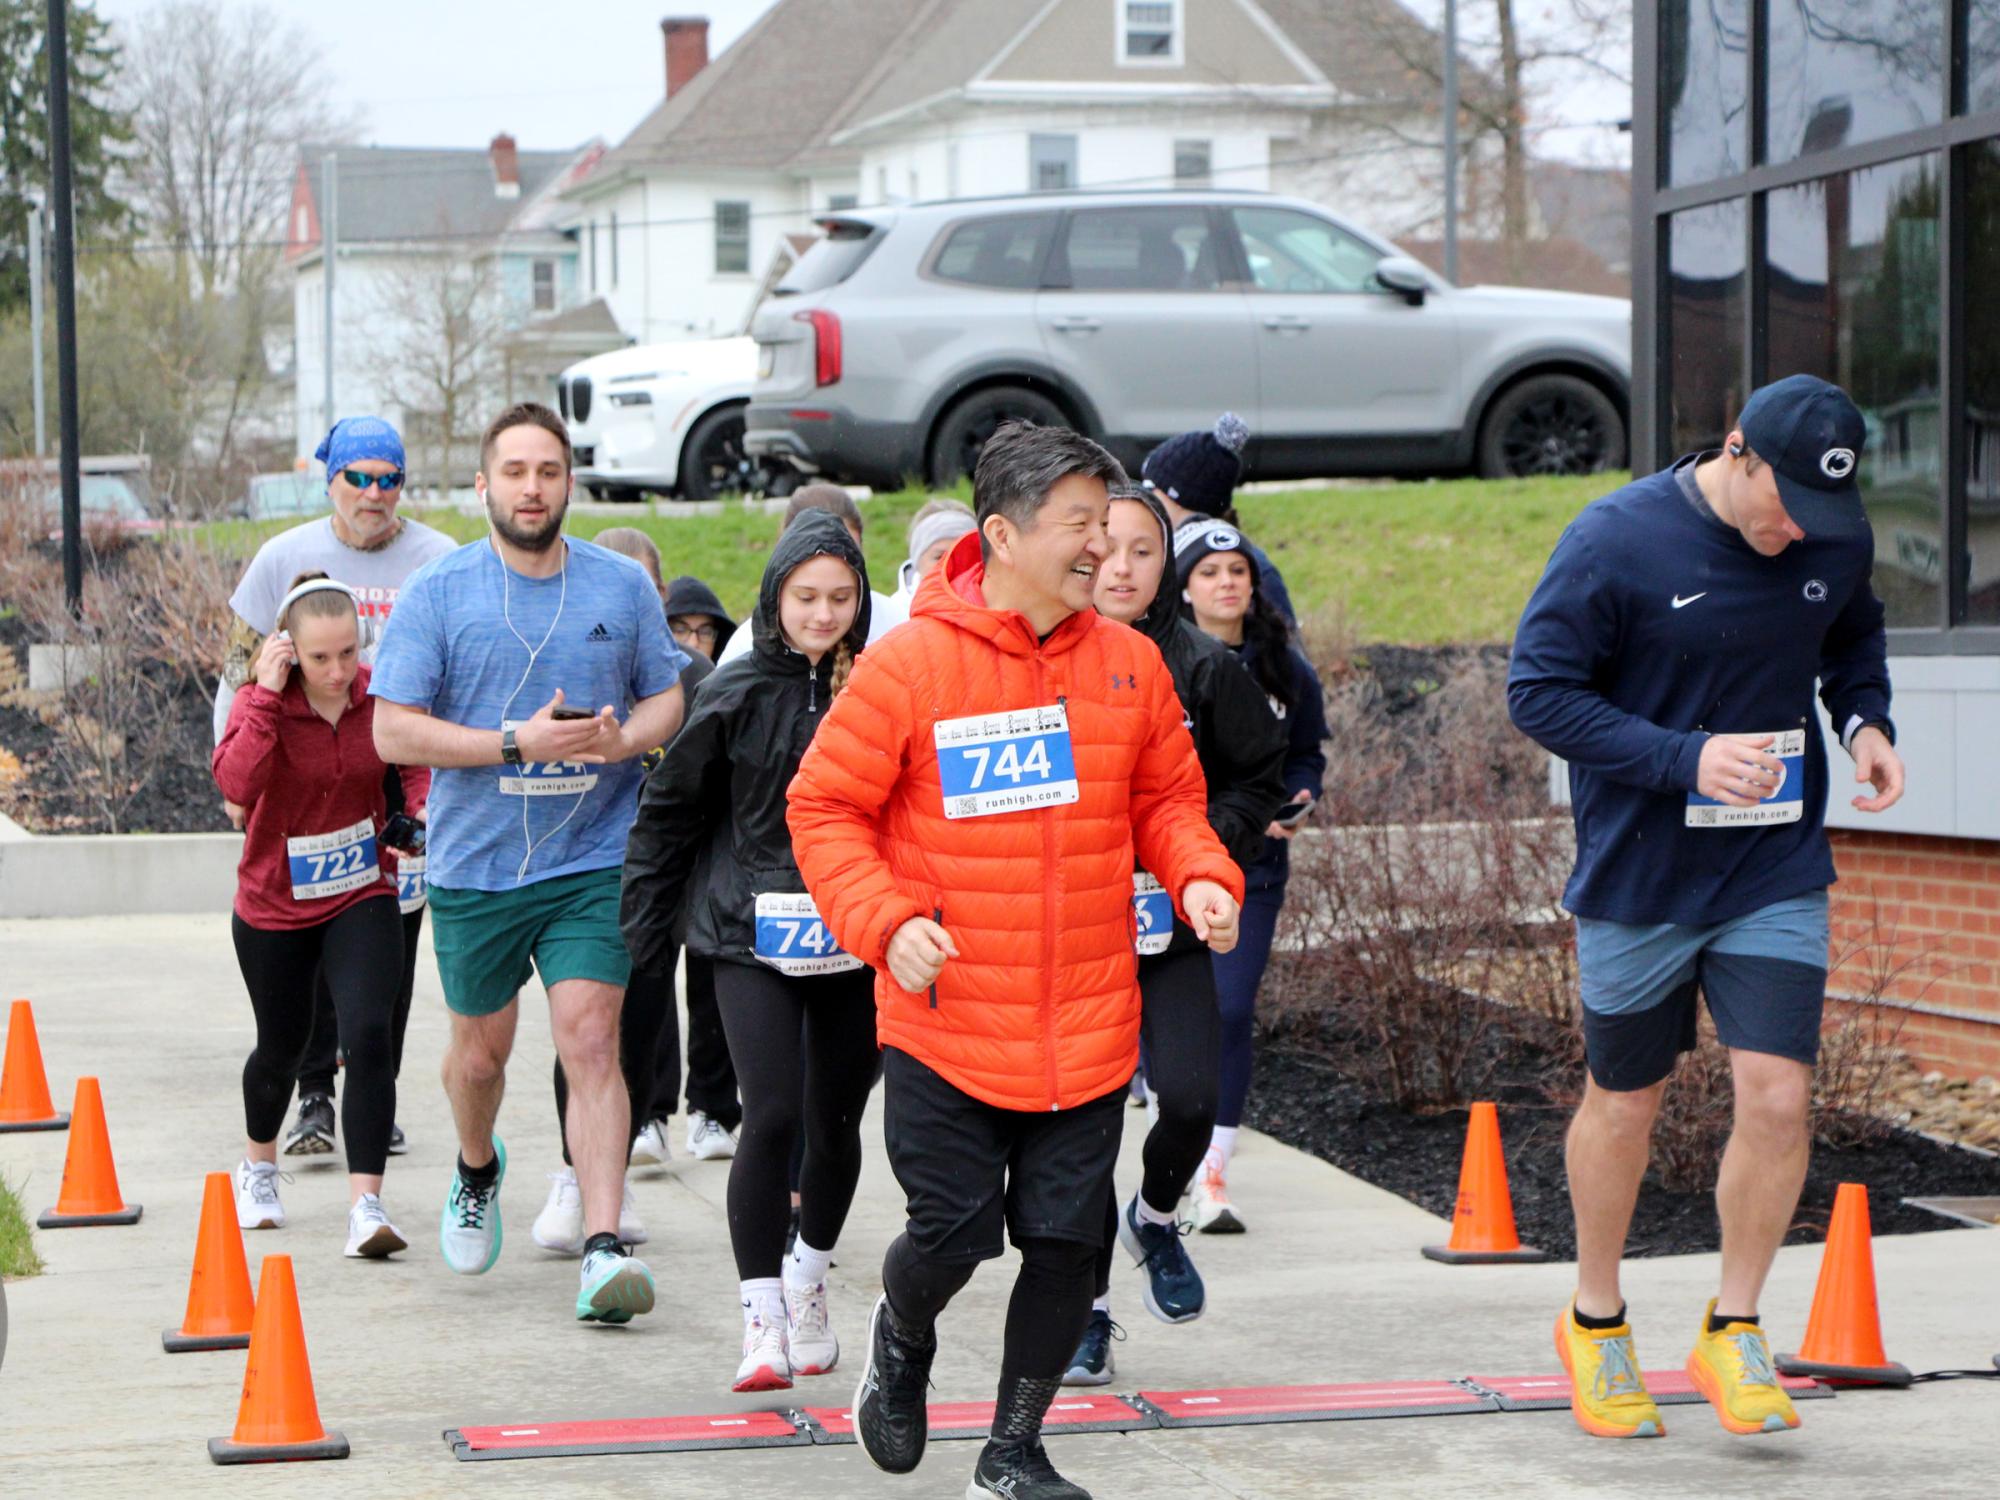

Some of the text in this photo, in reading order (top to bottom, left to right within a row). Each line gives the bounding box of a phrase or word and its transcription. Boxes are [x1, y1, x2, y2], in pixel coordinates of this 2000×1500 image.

[963, 740, 1051, 789] 744
[531, 782, 587, 791] runhigh.com
[986, 791, 1062, 808] runhigh.com
[1724, 811, 1789, 821] runhigh.com
[307, 845, 365, 881] 722
[321, 875, 371, 893] runhigh.com
[777, 921, 839, 954] 74
[788, 960, 850, 972] runhigh.com
